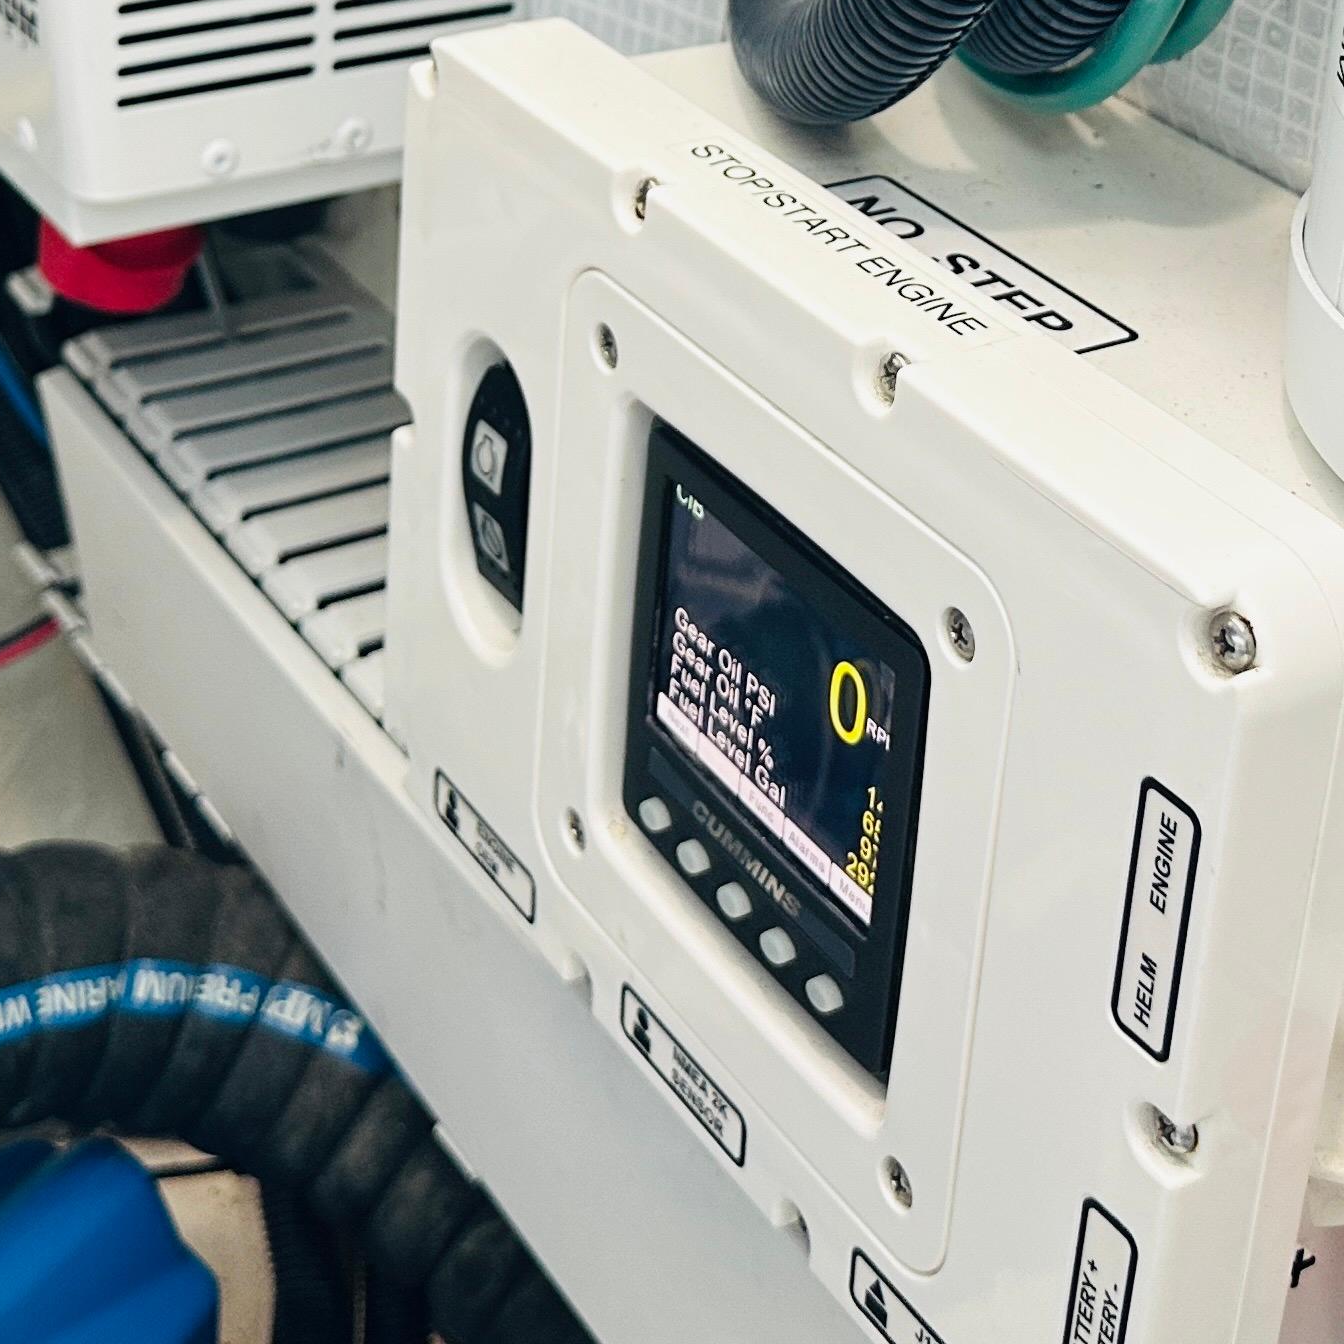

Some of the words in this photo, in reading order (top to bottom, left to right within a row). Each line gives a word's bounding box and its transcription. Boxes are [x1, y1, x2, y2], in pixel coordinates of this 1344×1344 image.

[689, 142, 868, 267] STOP/START
[856, 253, 989, 338] ENGINE
[670, 653, 706, 703] Fuel
[709, 691, 753, 749] Level
[757, 737, 774, 770] %
[672, 631, 713, 681] Gear
[715, 673, 740, 710] Oil
[674, 607, 715, 657] Gear
[717, 648, 742, 685] Oil
[745, 671, 776, 717] PSI
[829, 660, 867, 744] 0
[668, 677, 704, 726] Fuel
[706, 715, 751, 774] Level
[754, 764, 786, 809] Gal
[692, 799, 802, 918] CUMMINS
[1149, 811, 1179, 916] ENGINE
[1132, 953, 1158, 1031] HELM
